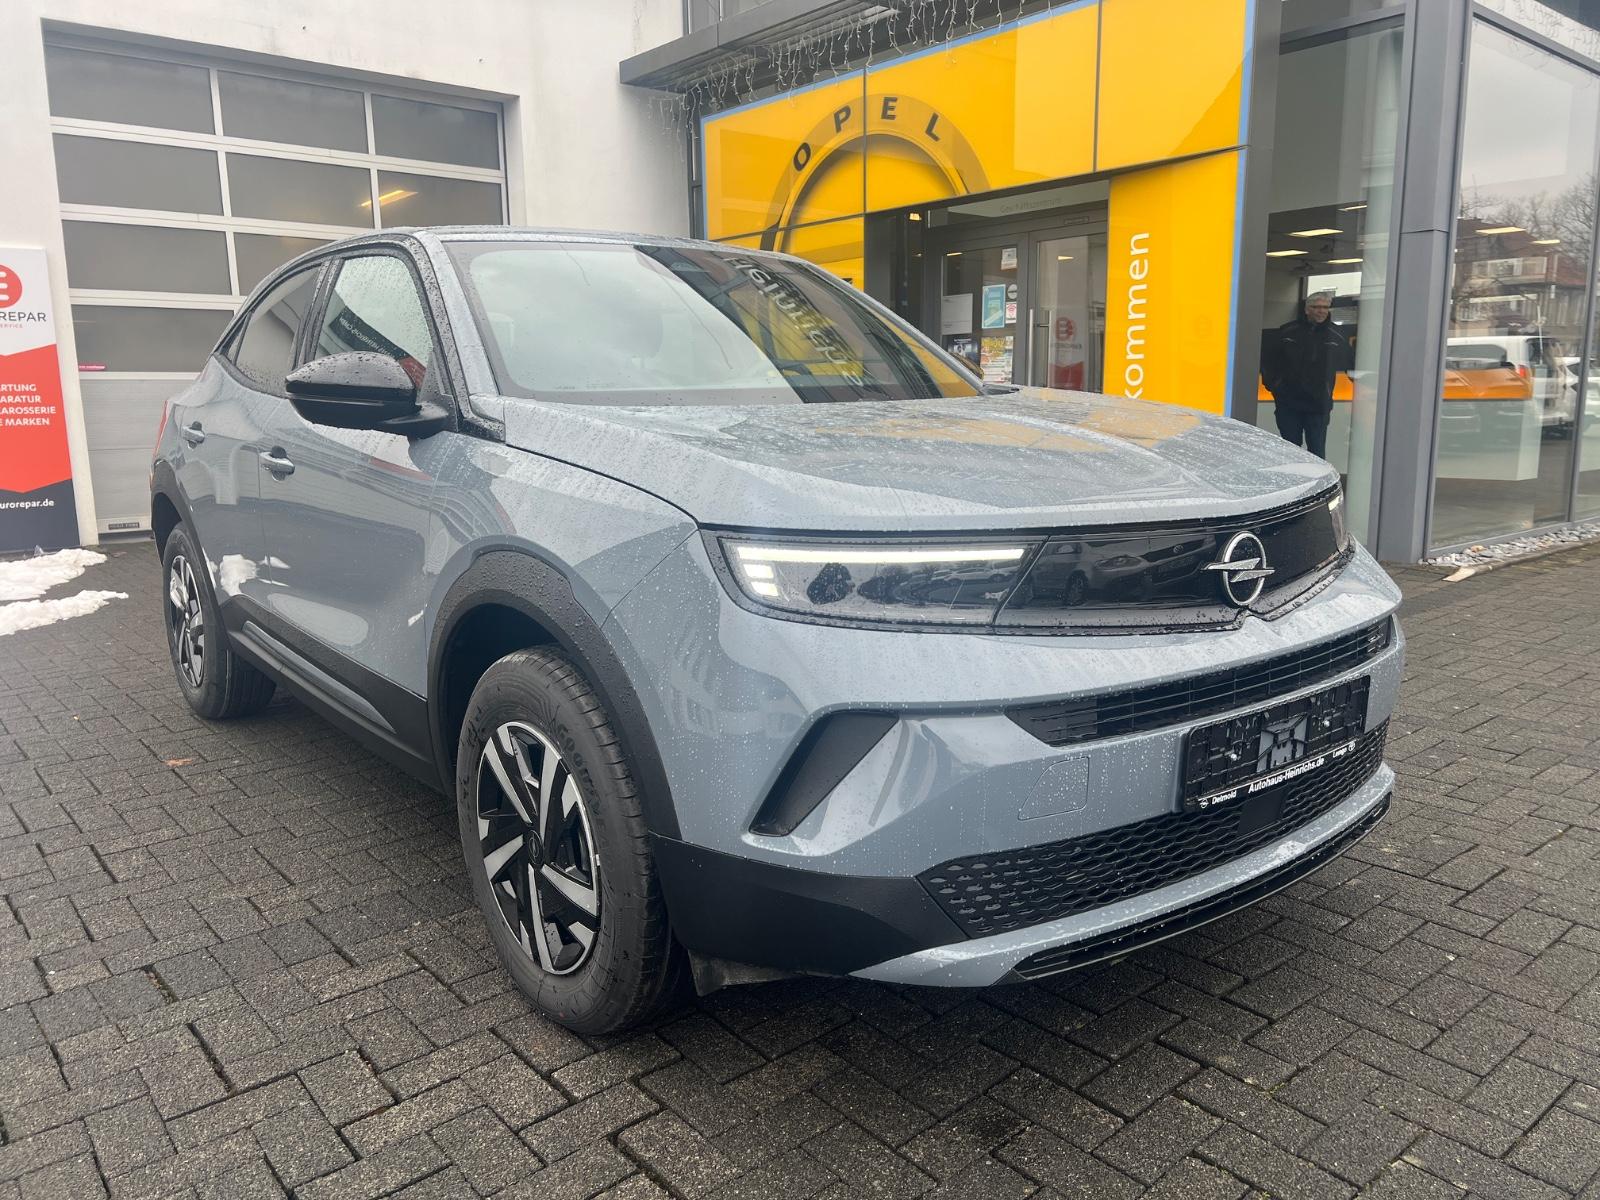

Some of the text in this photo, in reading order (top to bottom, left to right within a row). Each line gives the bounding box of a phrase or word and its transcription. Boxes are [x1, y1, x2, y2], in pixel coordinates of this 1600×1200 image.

[792, 96, 941, 172] OPEL
[0, 406, 57, 415] AROSSERIE
[5, 417, 50, 427] MARKEN
[1248, 757, 1325, 794] Autohaus-Heinrichs.de
